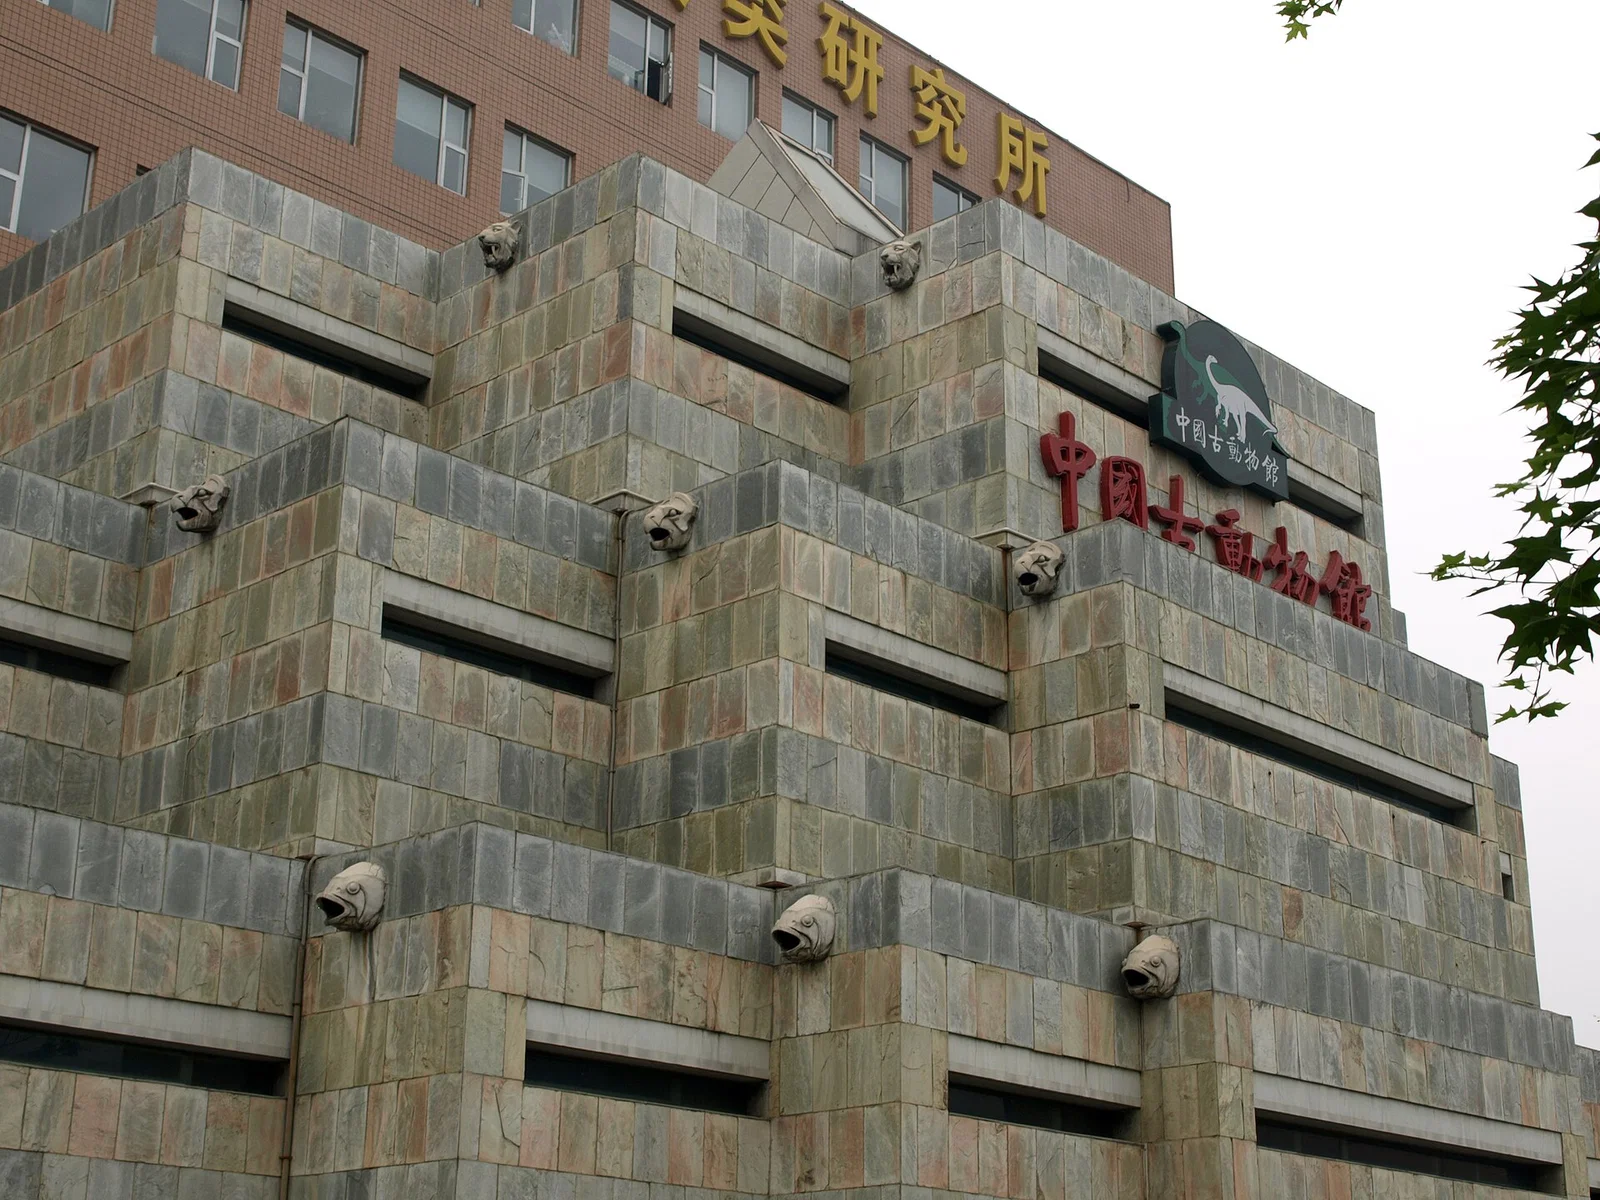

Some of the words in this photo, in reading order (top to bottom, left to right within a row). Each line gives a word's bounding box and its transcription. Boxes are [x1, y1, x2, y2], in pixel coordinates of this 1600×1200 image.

[668, 0, 1050, 218] 类研究所
[1175, 406, 1280, 488] 中國古動物館
